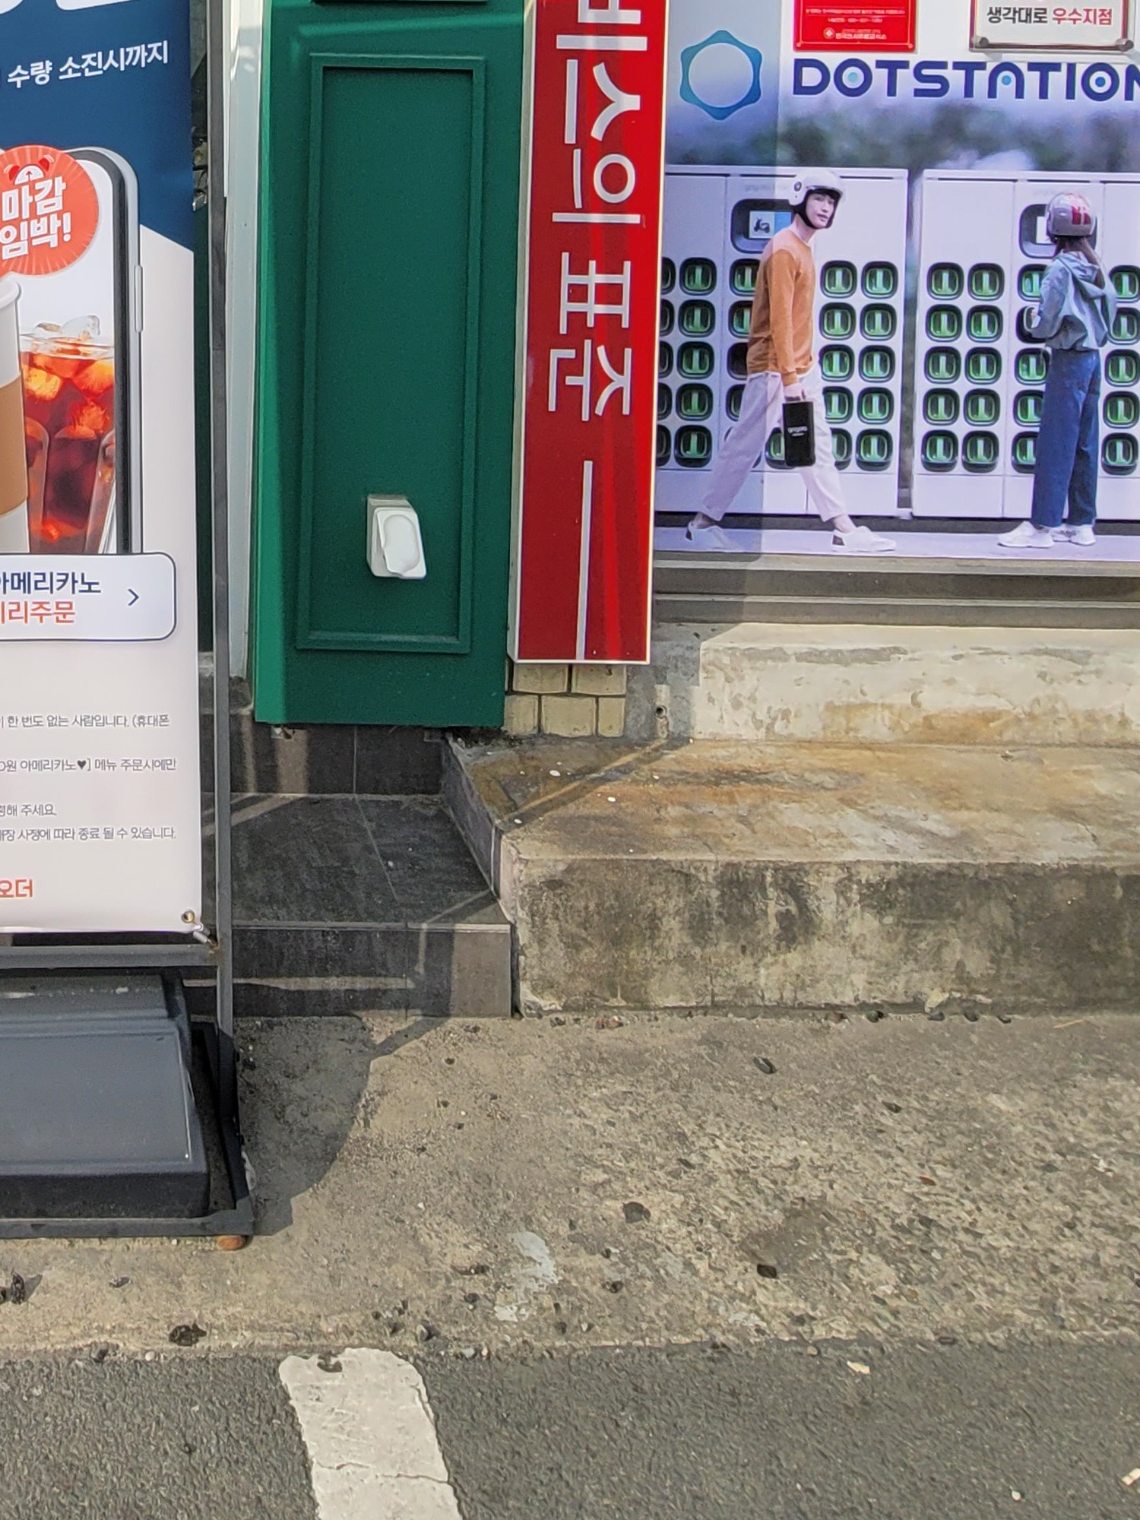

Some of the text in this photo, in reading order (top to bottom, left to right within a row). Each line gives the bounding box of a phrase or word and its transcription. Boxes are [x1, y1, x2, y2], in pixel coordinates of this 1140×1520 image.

[987, 7, 1113, 26] 생각대로 우수지점
[7, 59, 53, 88] 수량
[58, 40, 169, 82] 소진시까지
[1, 177, 66, 222] 마감
[548, 251, 632, 421] 표준
[7, 715, 18, 729] 한
[21, 715, 44, 728] 번도
[46, 714, 69, 728] 없는
[71, 714, 130, 728] 사람입니다.
[132, 714, 170, 728] (휴대폰
[94, 758, 117, 772] 메뉴
[120, 758, 177, 772] 주문시에만
[17, 828, 51, 842] 사정에
[53, 828, 75, 841] 따라
[78, 827, 100, 840] 종료
[103, 827, 114, 840] 될
[116, 827, 128, 840] 수
[130, 826, 177, 840] 있습니다.
